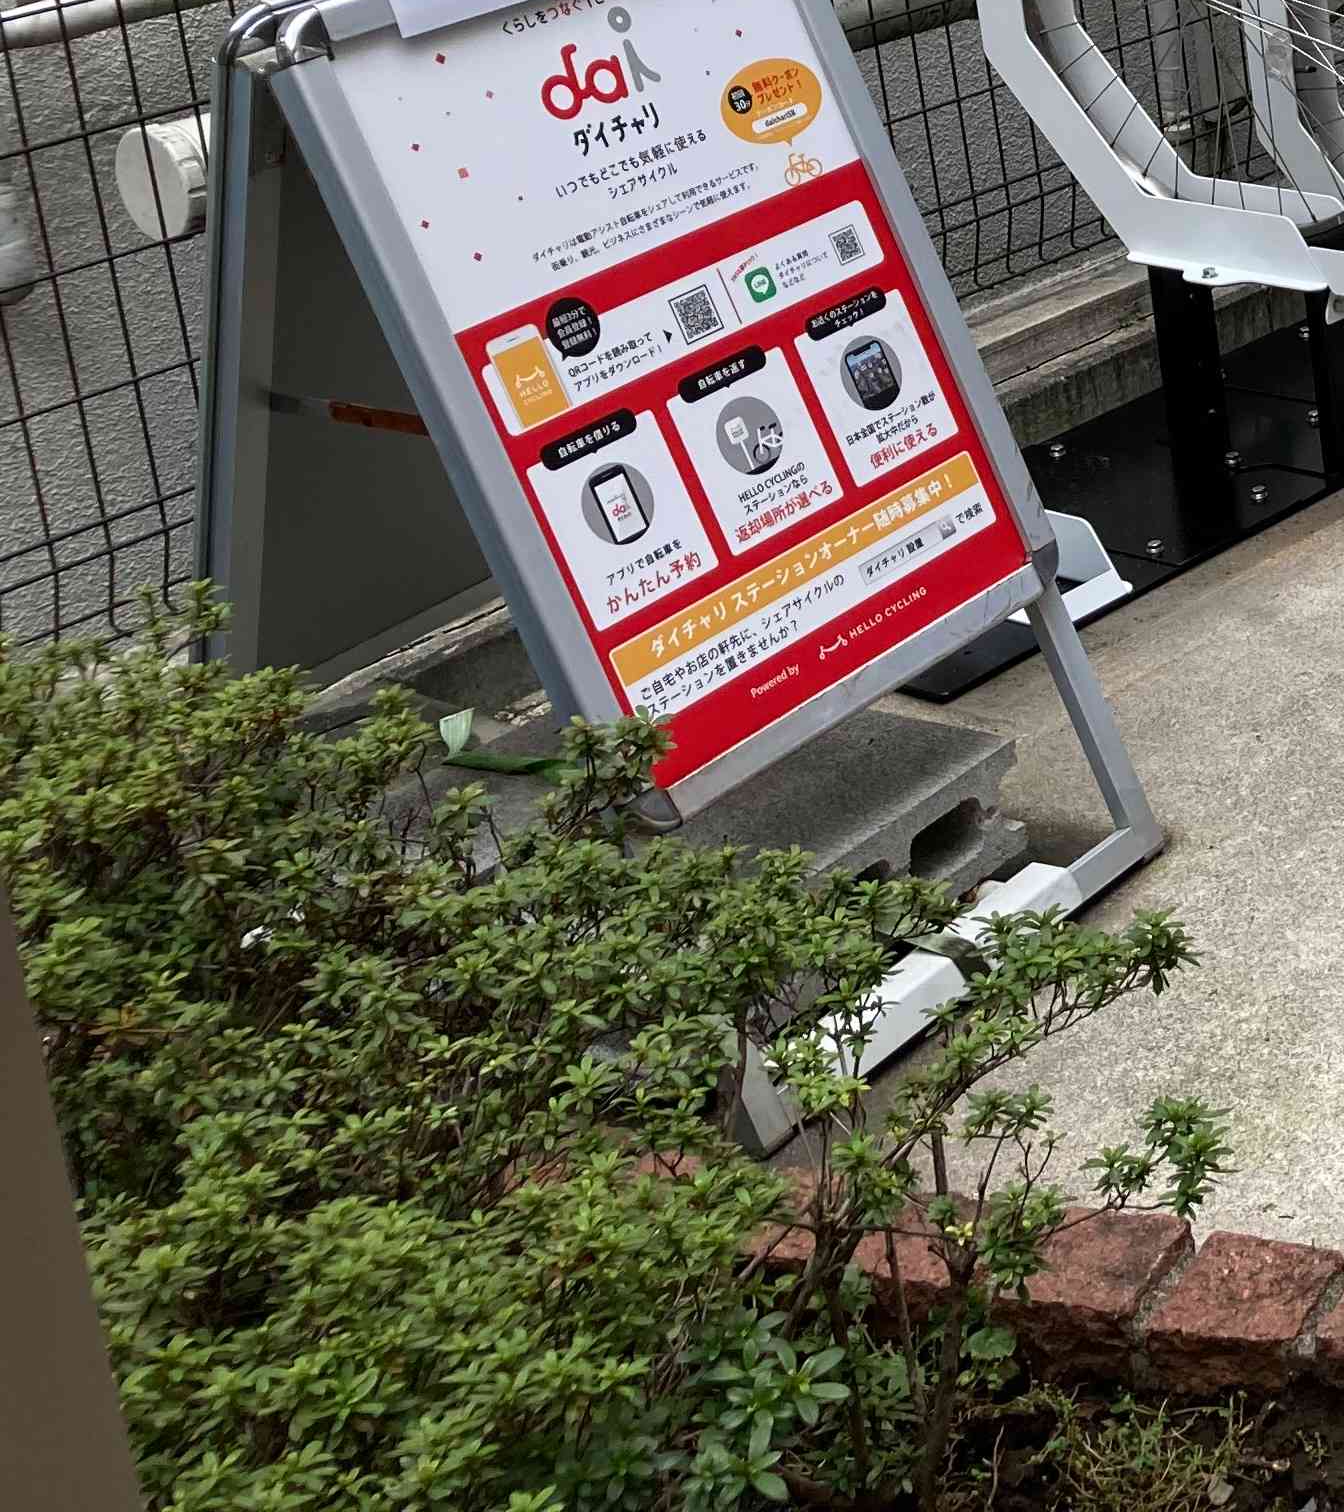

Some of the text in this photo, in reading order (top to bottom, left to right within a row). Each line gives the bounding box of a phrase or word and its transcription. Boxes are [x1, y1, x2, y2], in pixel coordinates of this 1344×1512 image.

[574, 102, 661, 157] ダイチャリ
[556, 129, 706, 199] いつでもどこでも気軽に使える
[608, 162, 678, 200] シェアサイクル
[568, 331, 653, 378] QRコードを読み取って
[697, 359, 747, 390] 自転車を返す
[557, 421, 621, 458] 自転車を借りる
[870, 422, 938, 469] 便利に使える
[735, 480, 833, 543] 返却場所が選べる
[739, 484, 765, 503] HELLO
[744, 474, 808, 514] ステーションなら
[954, 501, 984, 525] で検索
[606, 539, 682, 585] アプリで自転車を
[606, 551, 702, 614] かんたん予約
[650, 601, 726, 657] ダイチャリ
[848, 586, 928, 639] HELLO CYCLING
[750, 663, 800, 699] Powered by
